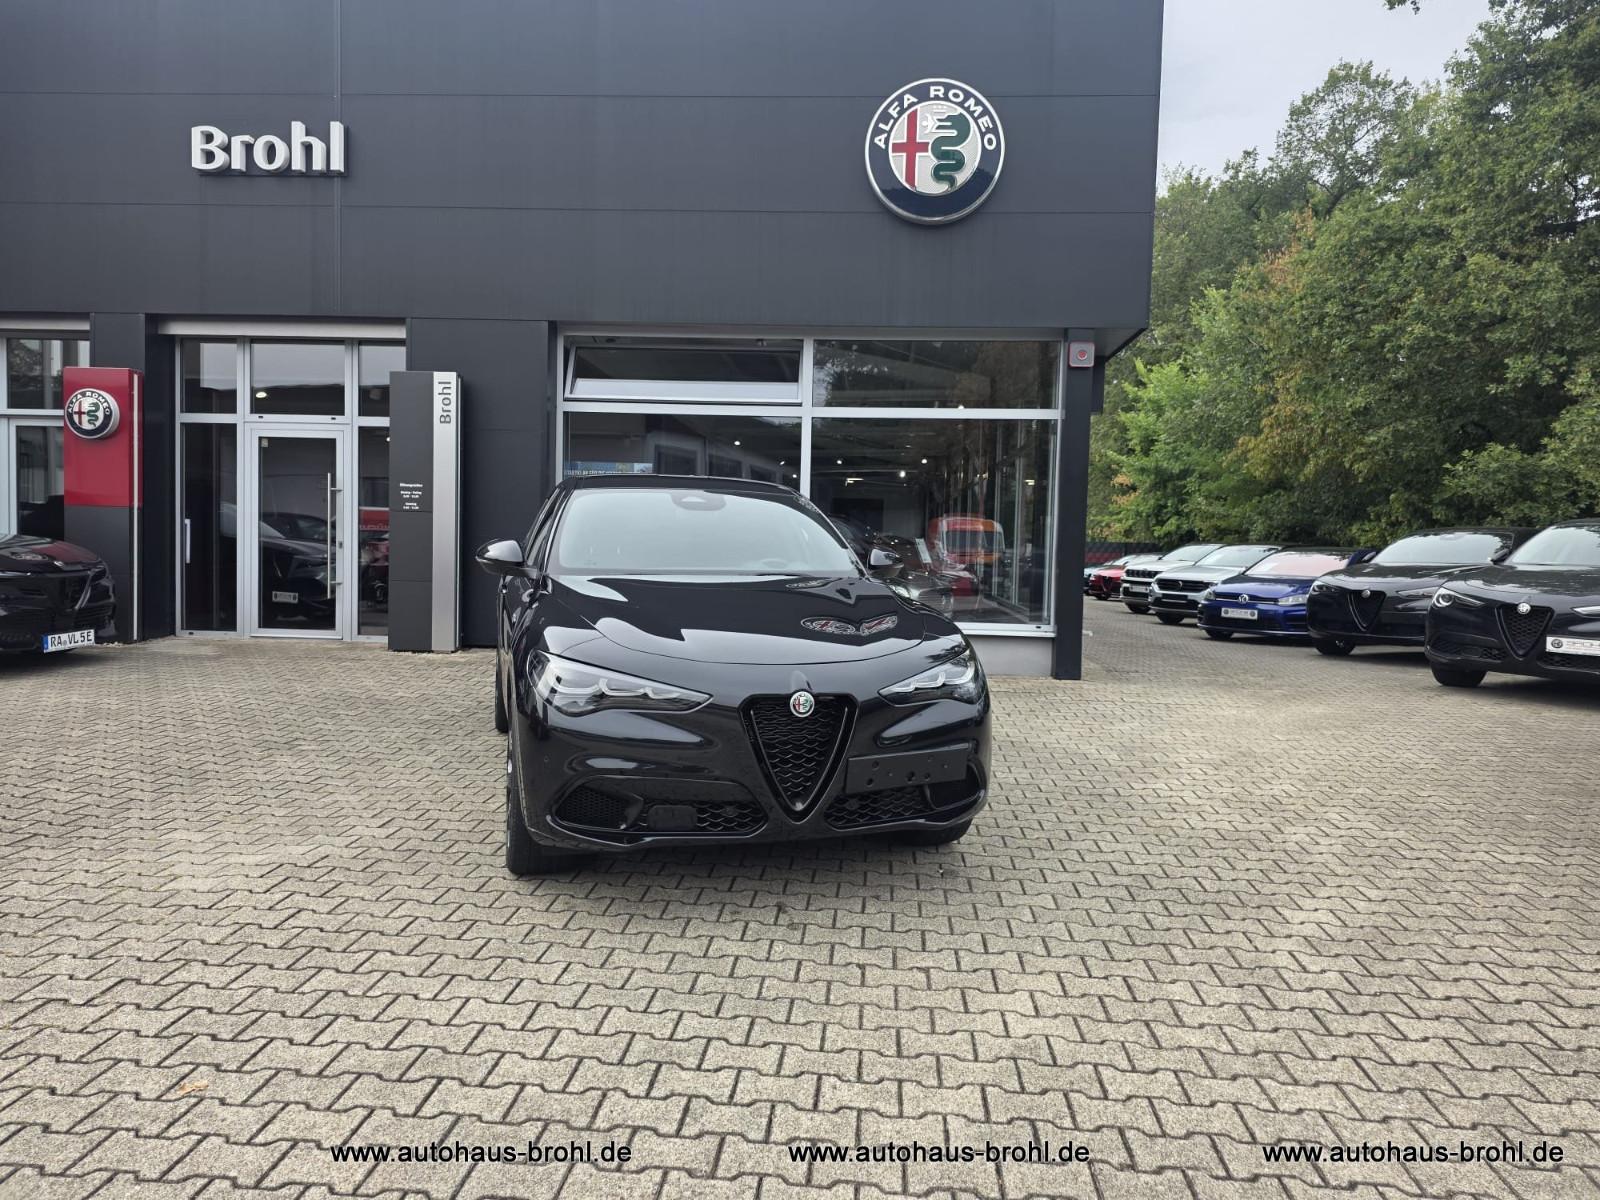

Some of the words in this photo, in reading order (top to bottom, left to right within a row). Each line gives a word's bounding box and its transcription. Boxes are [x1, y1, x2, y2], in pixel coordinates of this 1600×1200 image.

[874, 94, 919, 149] ALFA
[929, 86, 997, 151] ROMEO
[191, 120, 345, 173] Brohl
[68, 394, 83, 414] ALFA
[85, 391, 111, 415] ROMEO
[438, 381, 452, 424] Brohl
[50, 635, 62, 648] RA
